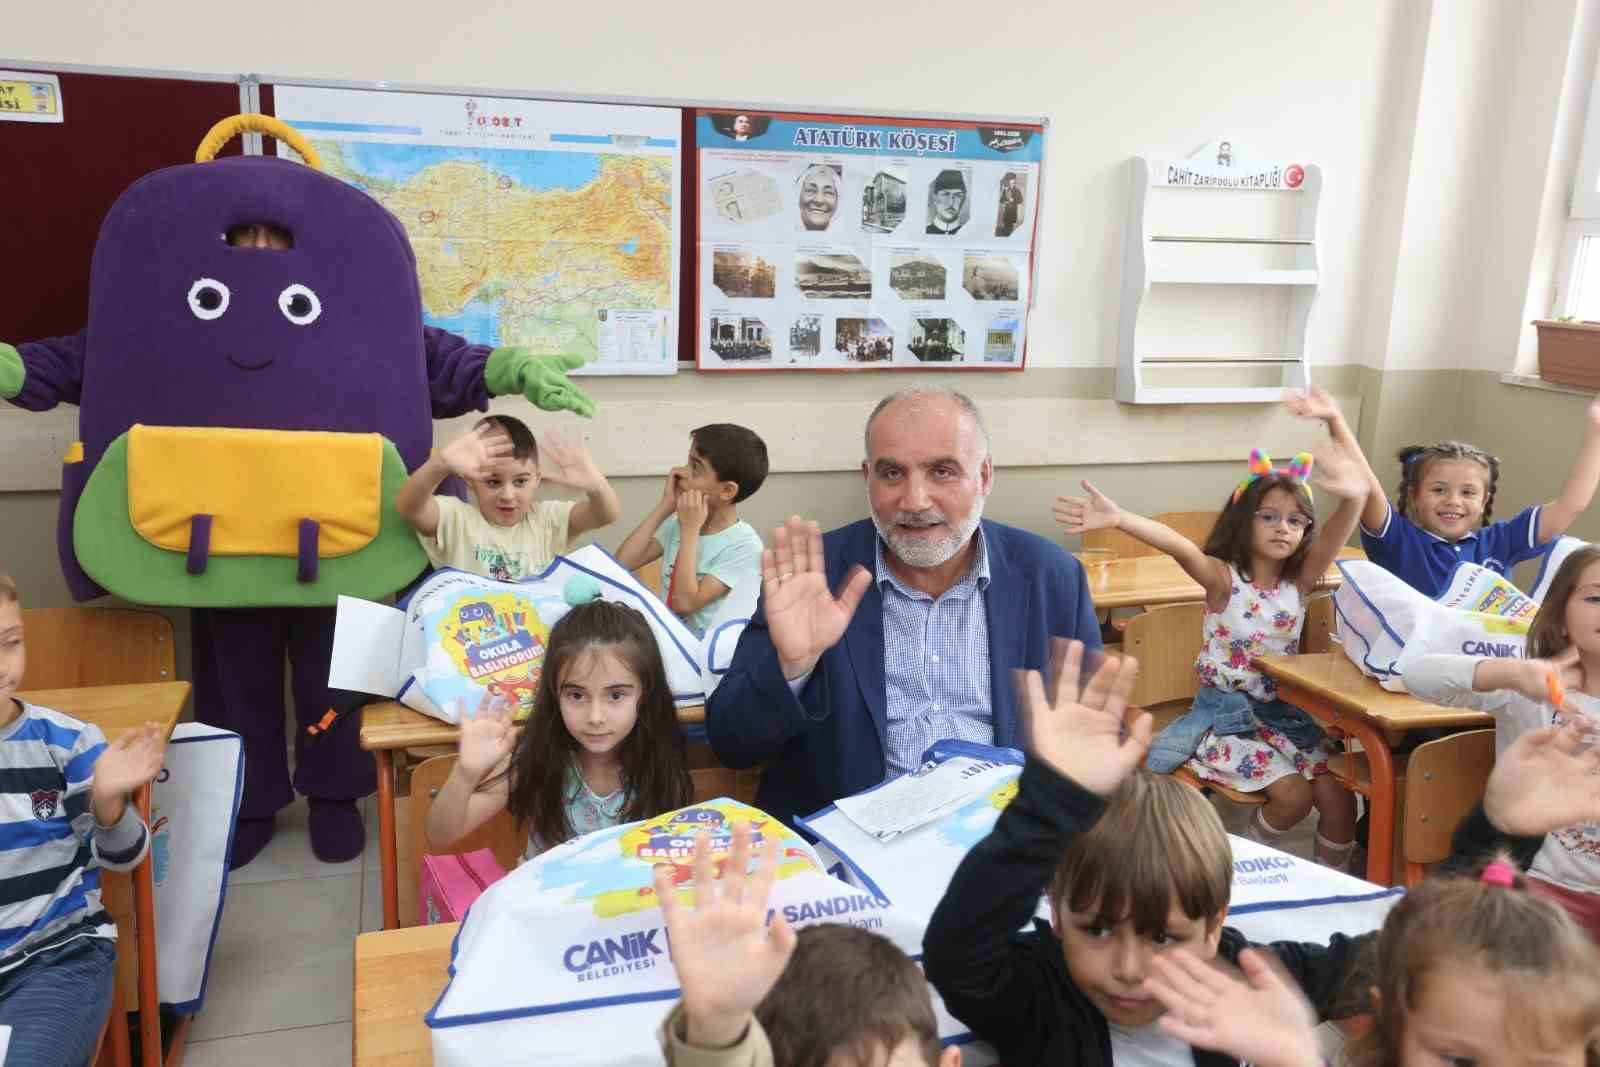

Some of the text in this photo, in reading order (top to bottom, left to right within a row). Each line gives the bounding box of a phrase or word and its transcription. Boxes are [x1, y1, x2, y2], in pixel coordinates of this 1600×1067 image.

[794, 126, 958, 156] ATATÜRK KÖŞESİ
[1168, 165, 1192, 185] CAHİT
[479, 639, 523, 660] OKULA
[577, 958, 656, 983] BELEDİYESİ
